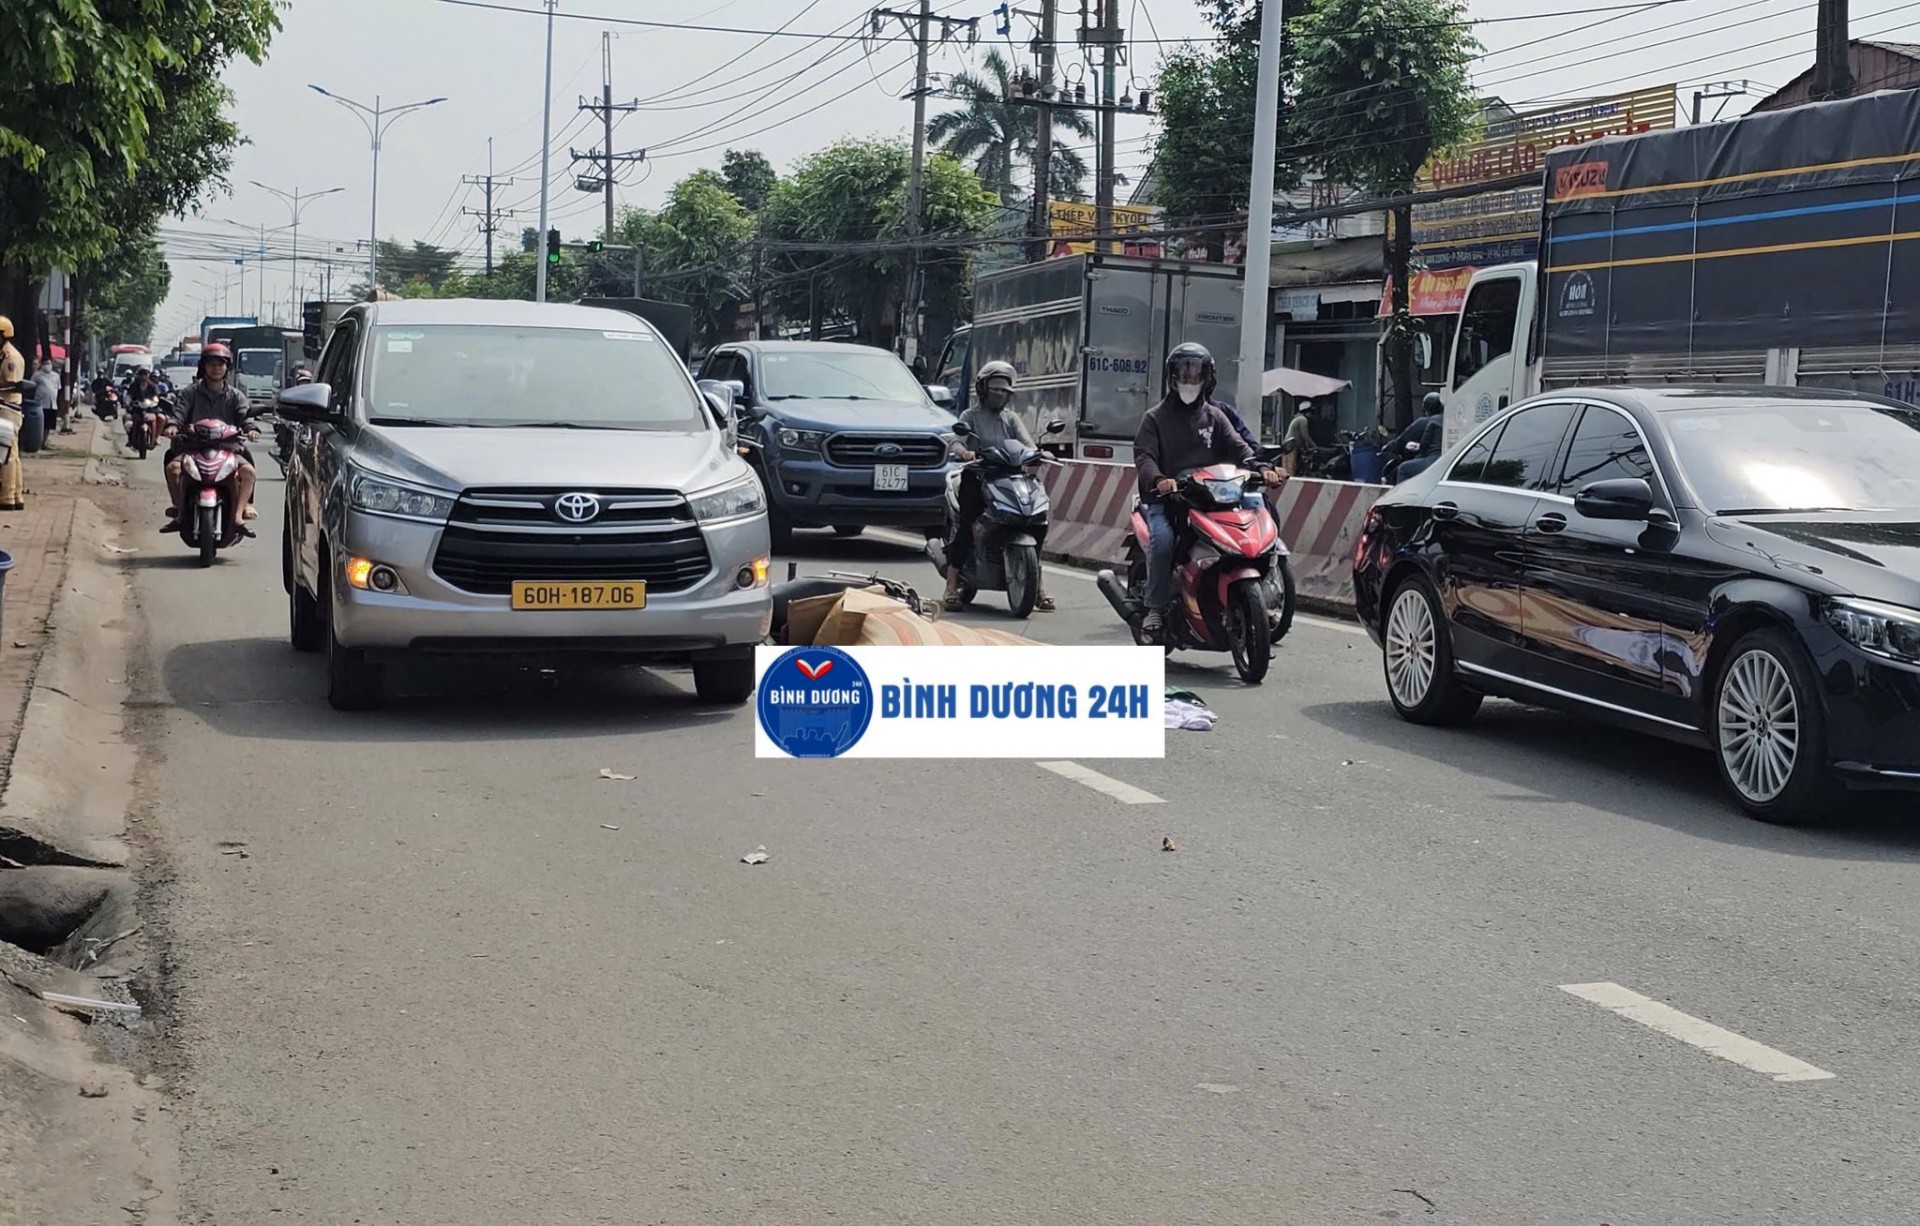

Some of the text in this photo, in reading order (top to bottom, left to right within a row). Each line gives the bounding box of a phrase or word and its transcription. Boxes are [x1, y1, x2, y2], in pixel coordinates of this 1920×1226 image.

[1089, 357, 1147, 374] 61C-606.92
[882, 466, 900, 477] 61C
[524, 587, 634, 604] 60H-187.06
